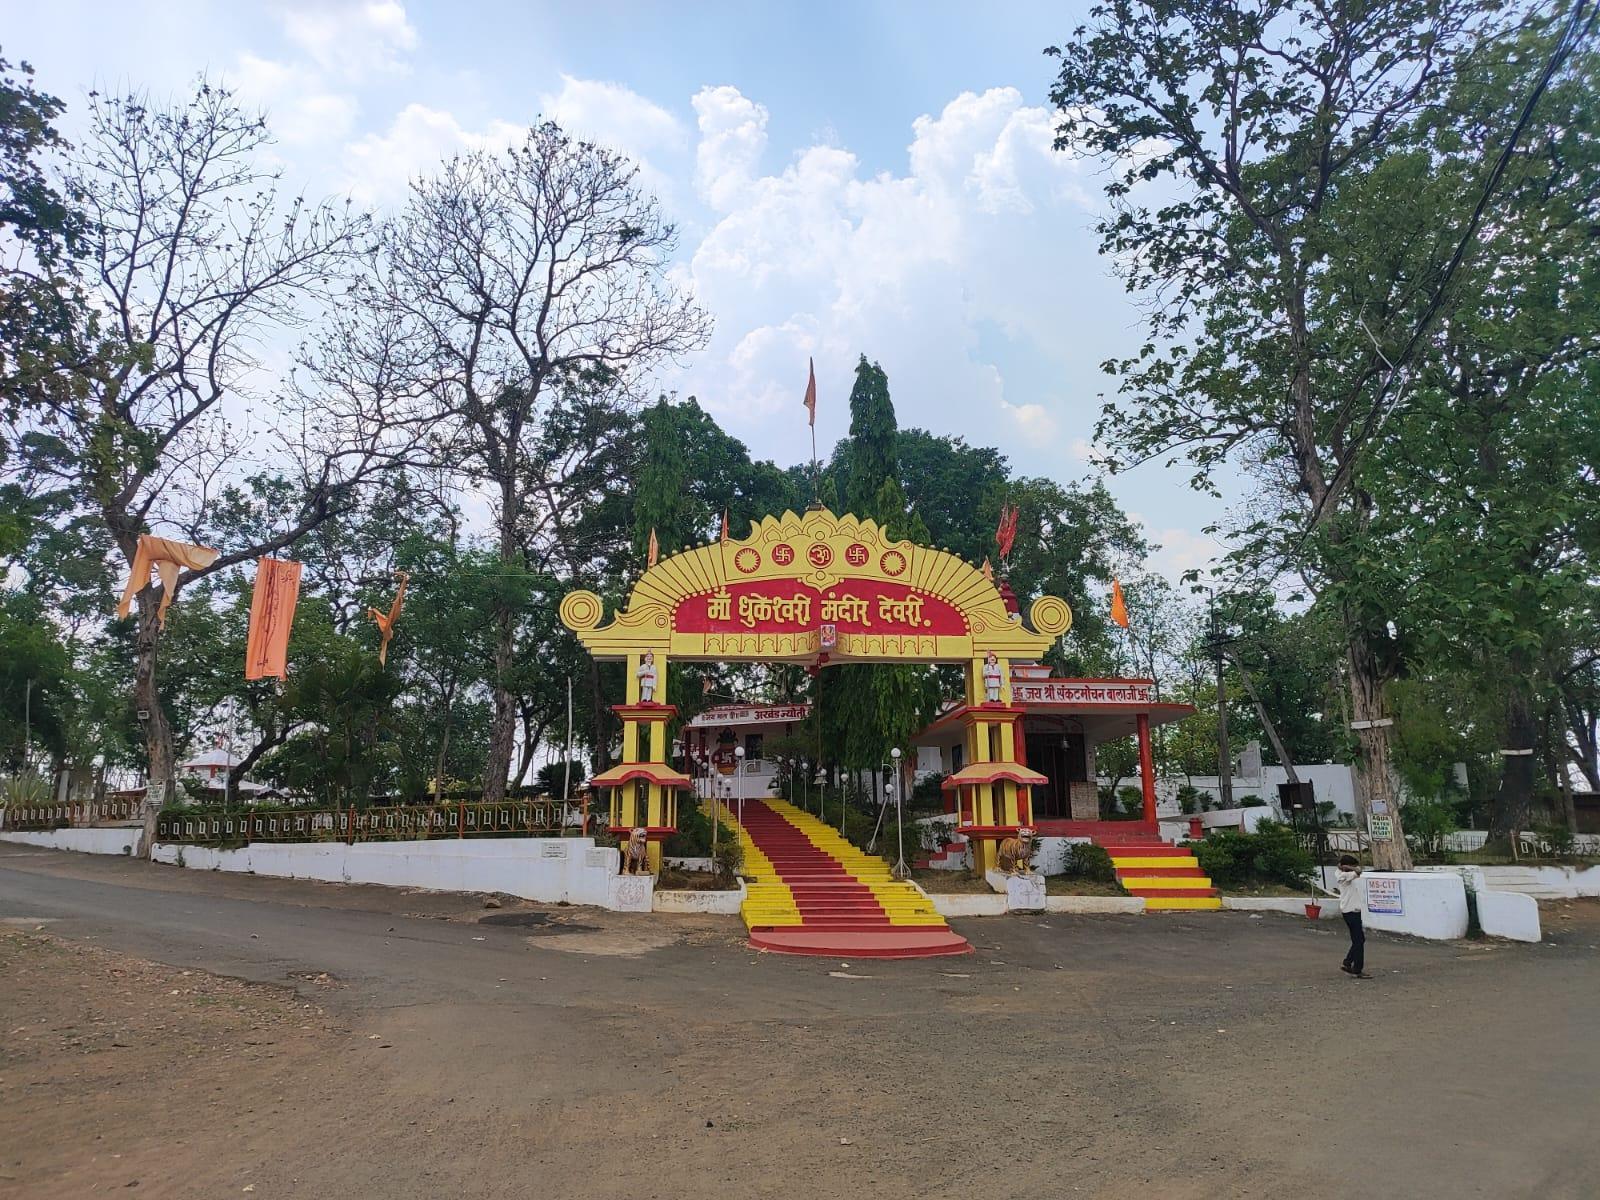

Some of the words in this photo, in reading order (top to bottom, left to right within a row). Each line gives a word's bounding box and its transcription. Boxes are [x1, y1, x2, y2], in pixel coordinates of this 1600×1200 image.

[1025, 686, 1042, 700] जय
[1044, 684, 1055, 701] श्री
[1057, 684, 1106, 701] संकटमोचन
[1368, 880, 1396, 889] MS-CIT
